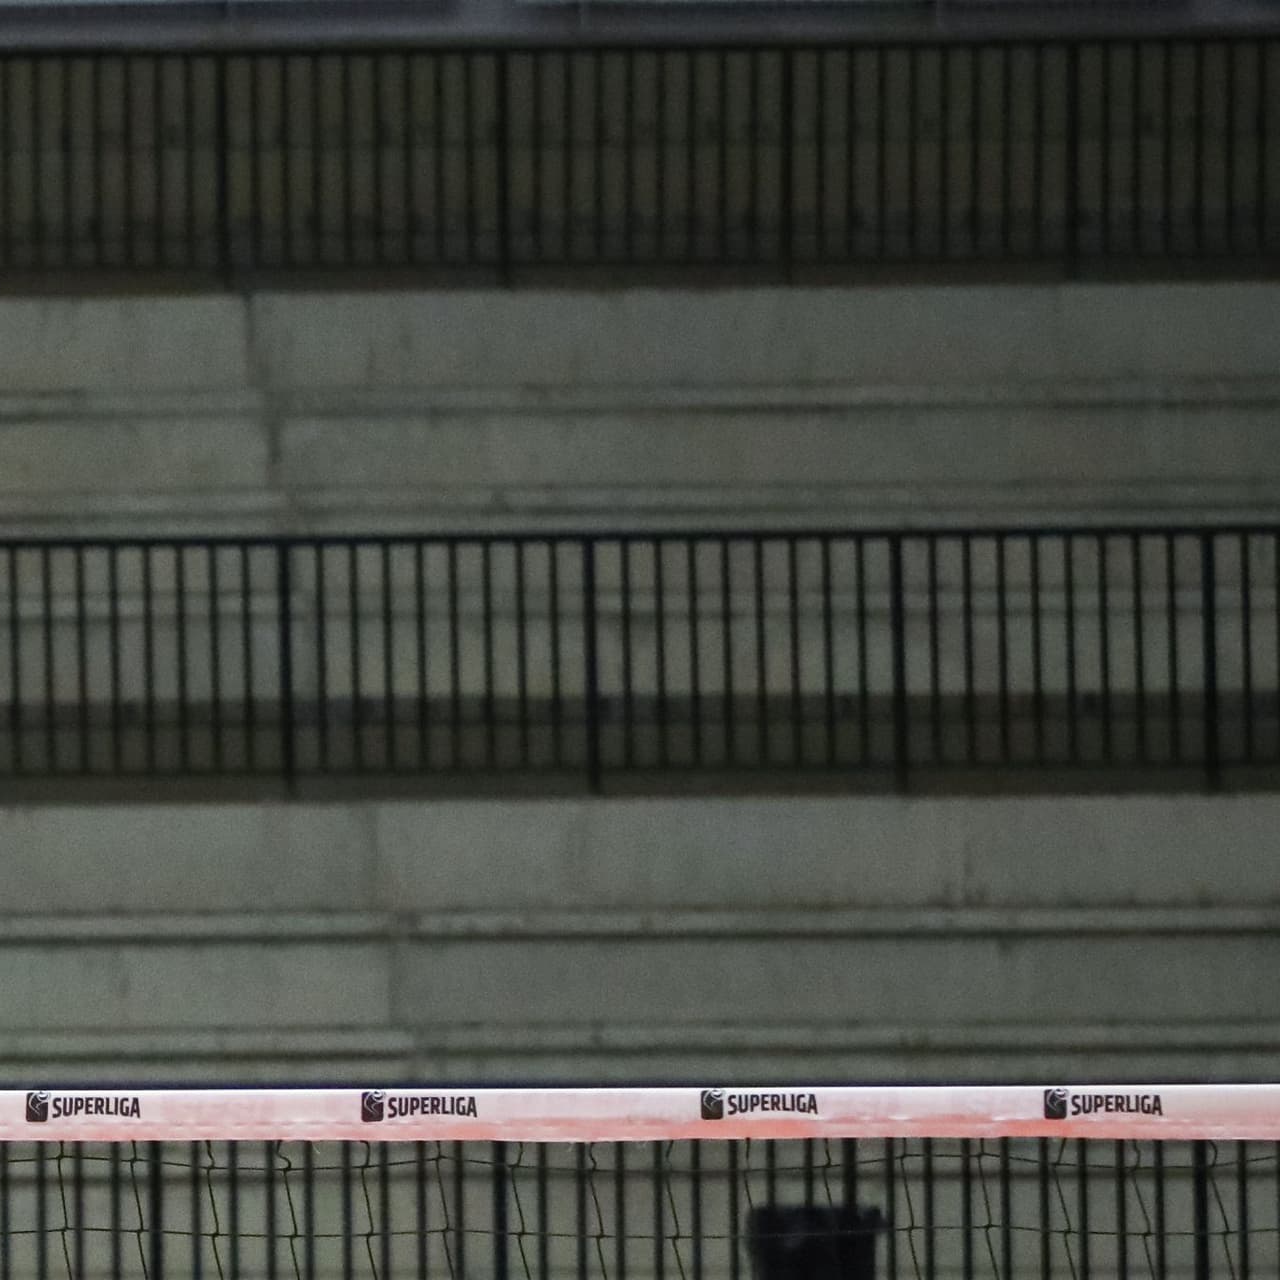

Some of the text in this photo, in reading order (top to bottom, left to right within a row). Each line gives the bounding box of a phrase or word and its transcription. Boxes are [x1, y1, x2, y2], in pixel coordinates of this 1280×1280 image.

[53, 1098, 140, 1119] SUPERLIGA
[388, 1097, 477, 1118] SUPERLIGA
[728, 1094, 817, 1115] SUPERLIGA
[1072, 1095, 1162, 1115] SUPERLIGA
